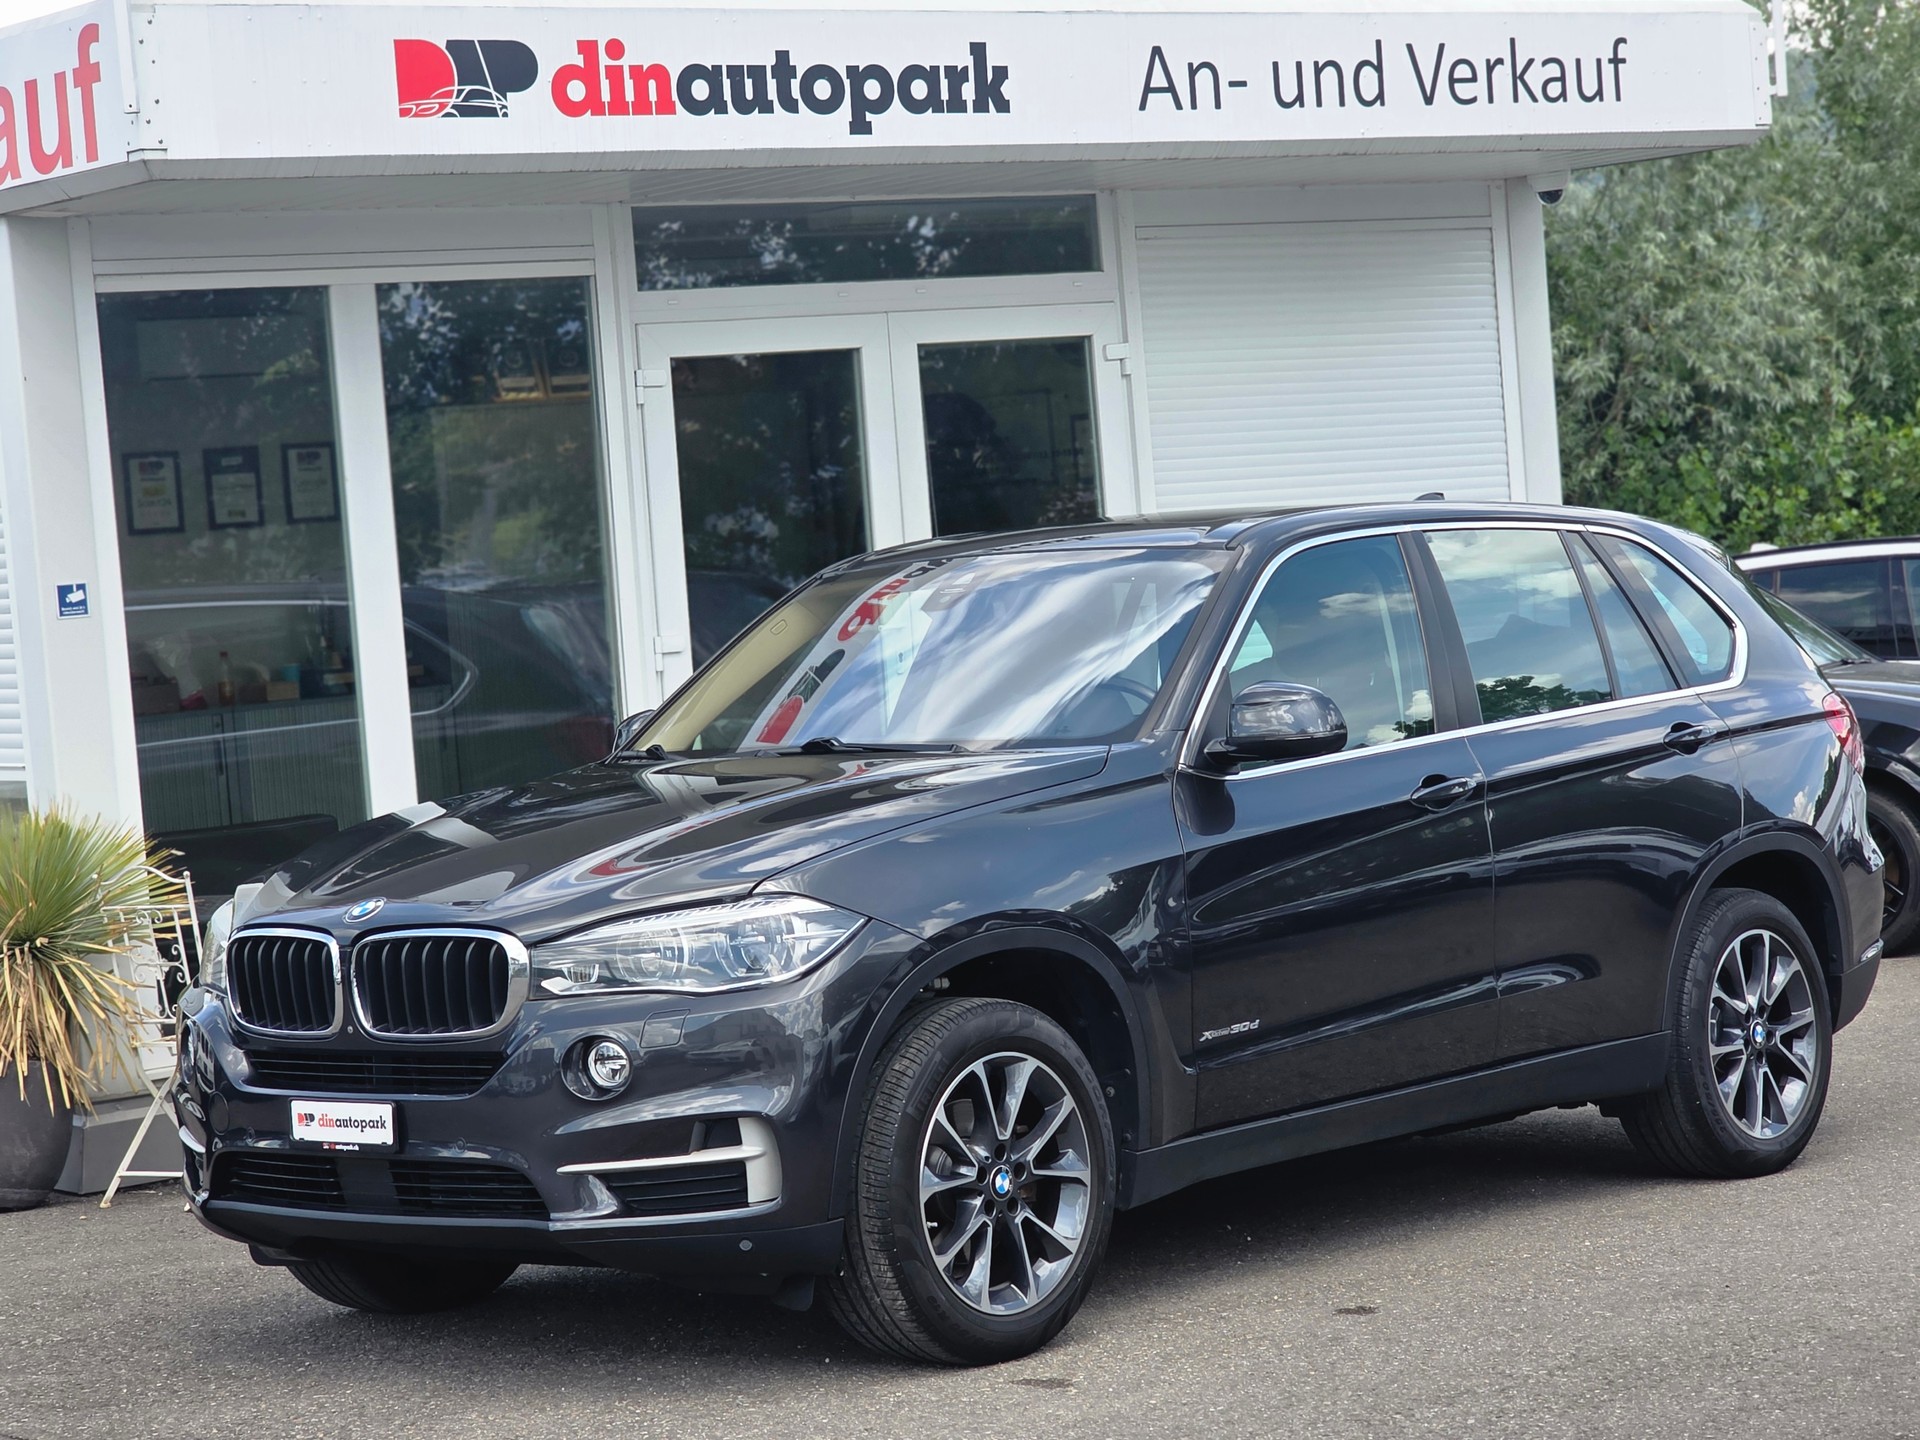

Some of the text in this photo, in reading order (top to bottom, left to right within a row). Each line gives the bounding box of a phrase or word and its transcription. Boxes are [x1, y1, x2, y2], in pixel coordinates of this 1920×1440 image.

[551, 38, 1010, 135] dinautopark
[1139, 37, 1627, 110] An- und Verkauf
[318, 1113, 386, 1132] dinautopark
